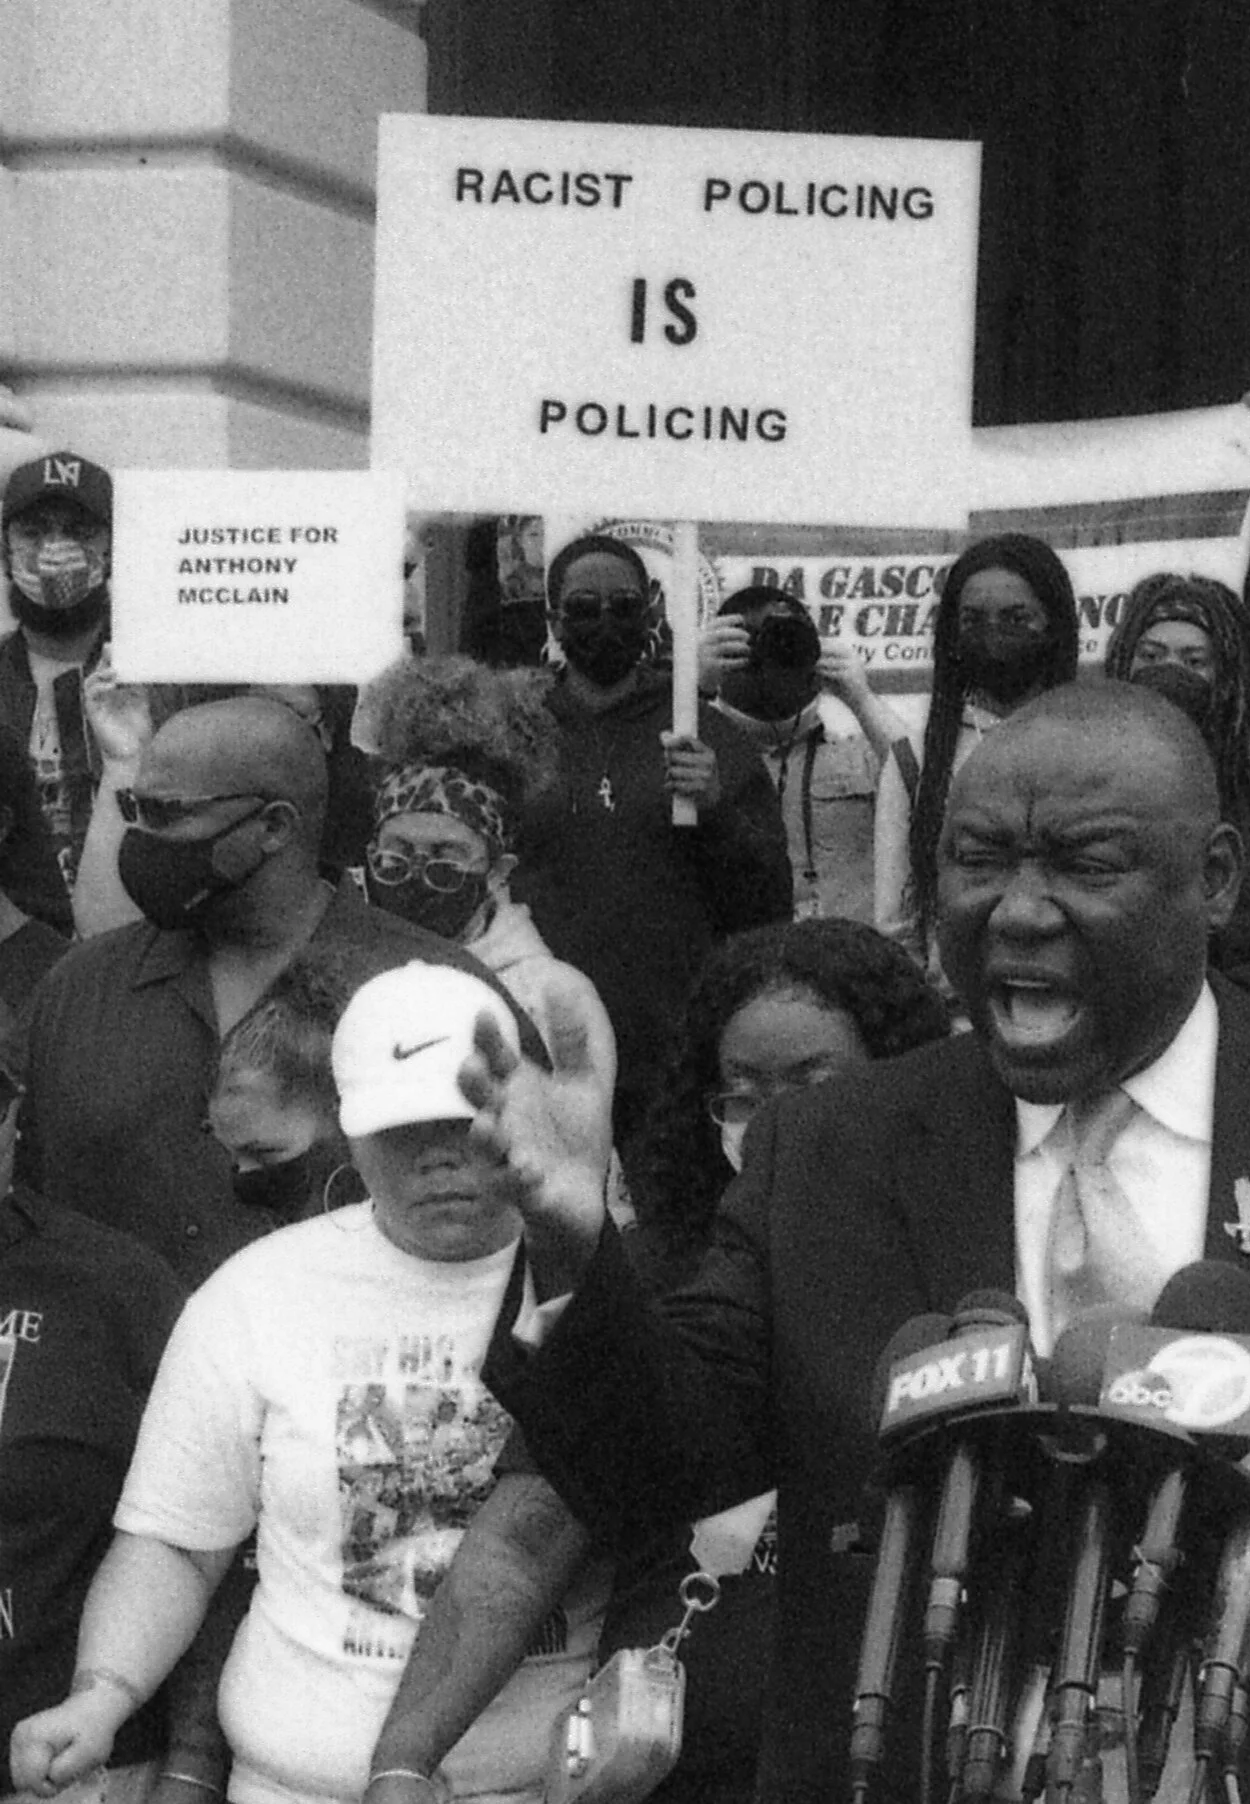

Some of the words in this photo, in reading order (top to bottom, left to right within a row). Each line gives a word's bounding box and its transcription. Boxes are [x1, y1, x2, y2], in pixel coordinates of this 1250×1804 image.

[455, 167, 634, 209] RACIST
[703, 177, 935, 221] POLICING
[630, 277, 698, 346] IS
[539, 399, 788, 443] POLICING
[177, 525, 282, 546] JUSTICE
[289, 525, 339, 546] FOR
[177, 556, 298, 576] ANTHONY
[177, 586, 290, 606] MCCLAIN
[887, 1355, 967, 1413] FOX
[970, 1342, 1012, 1384] 11
[1109, 1372, 1174, 1408] abc
